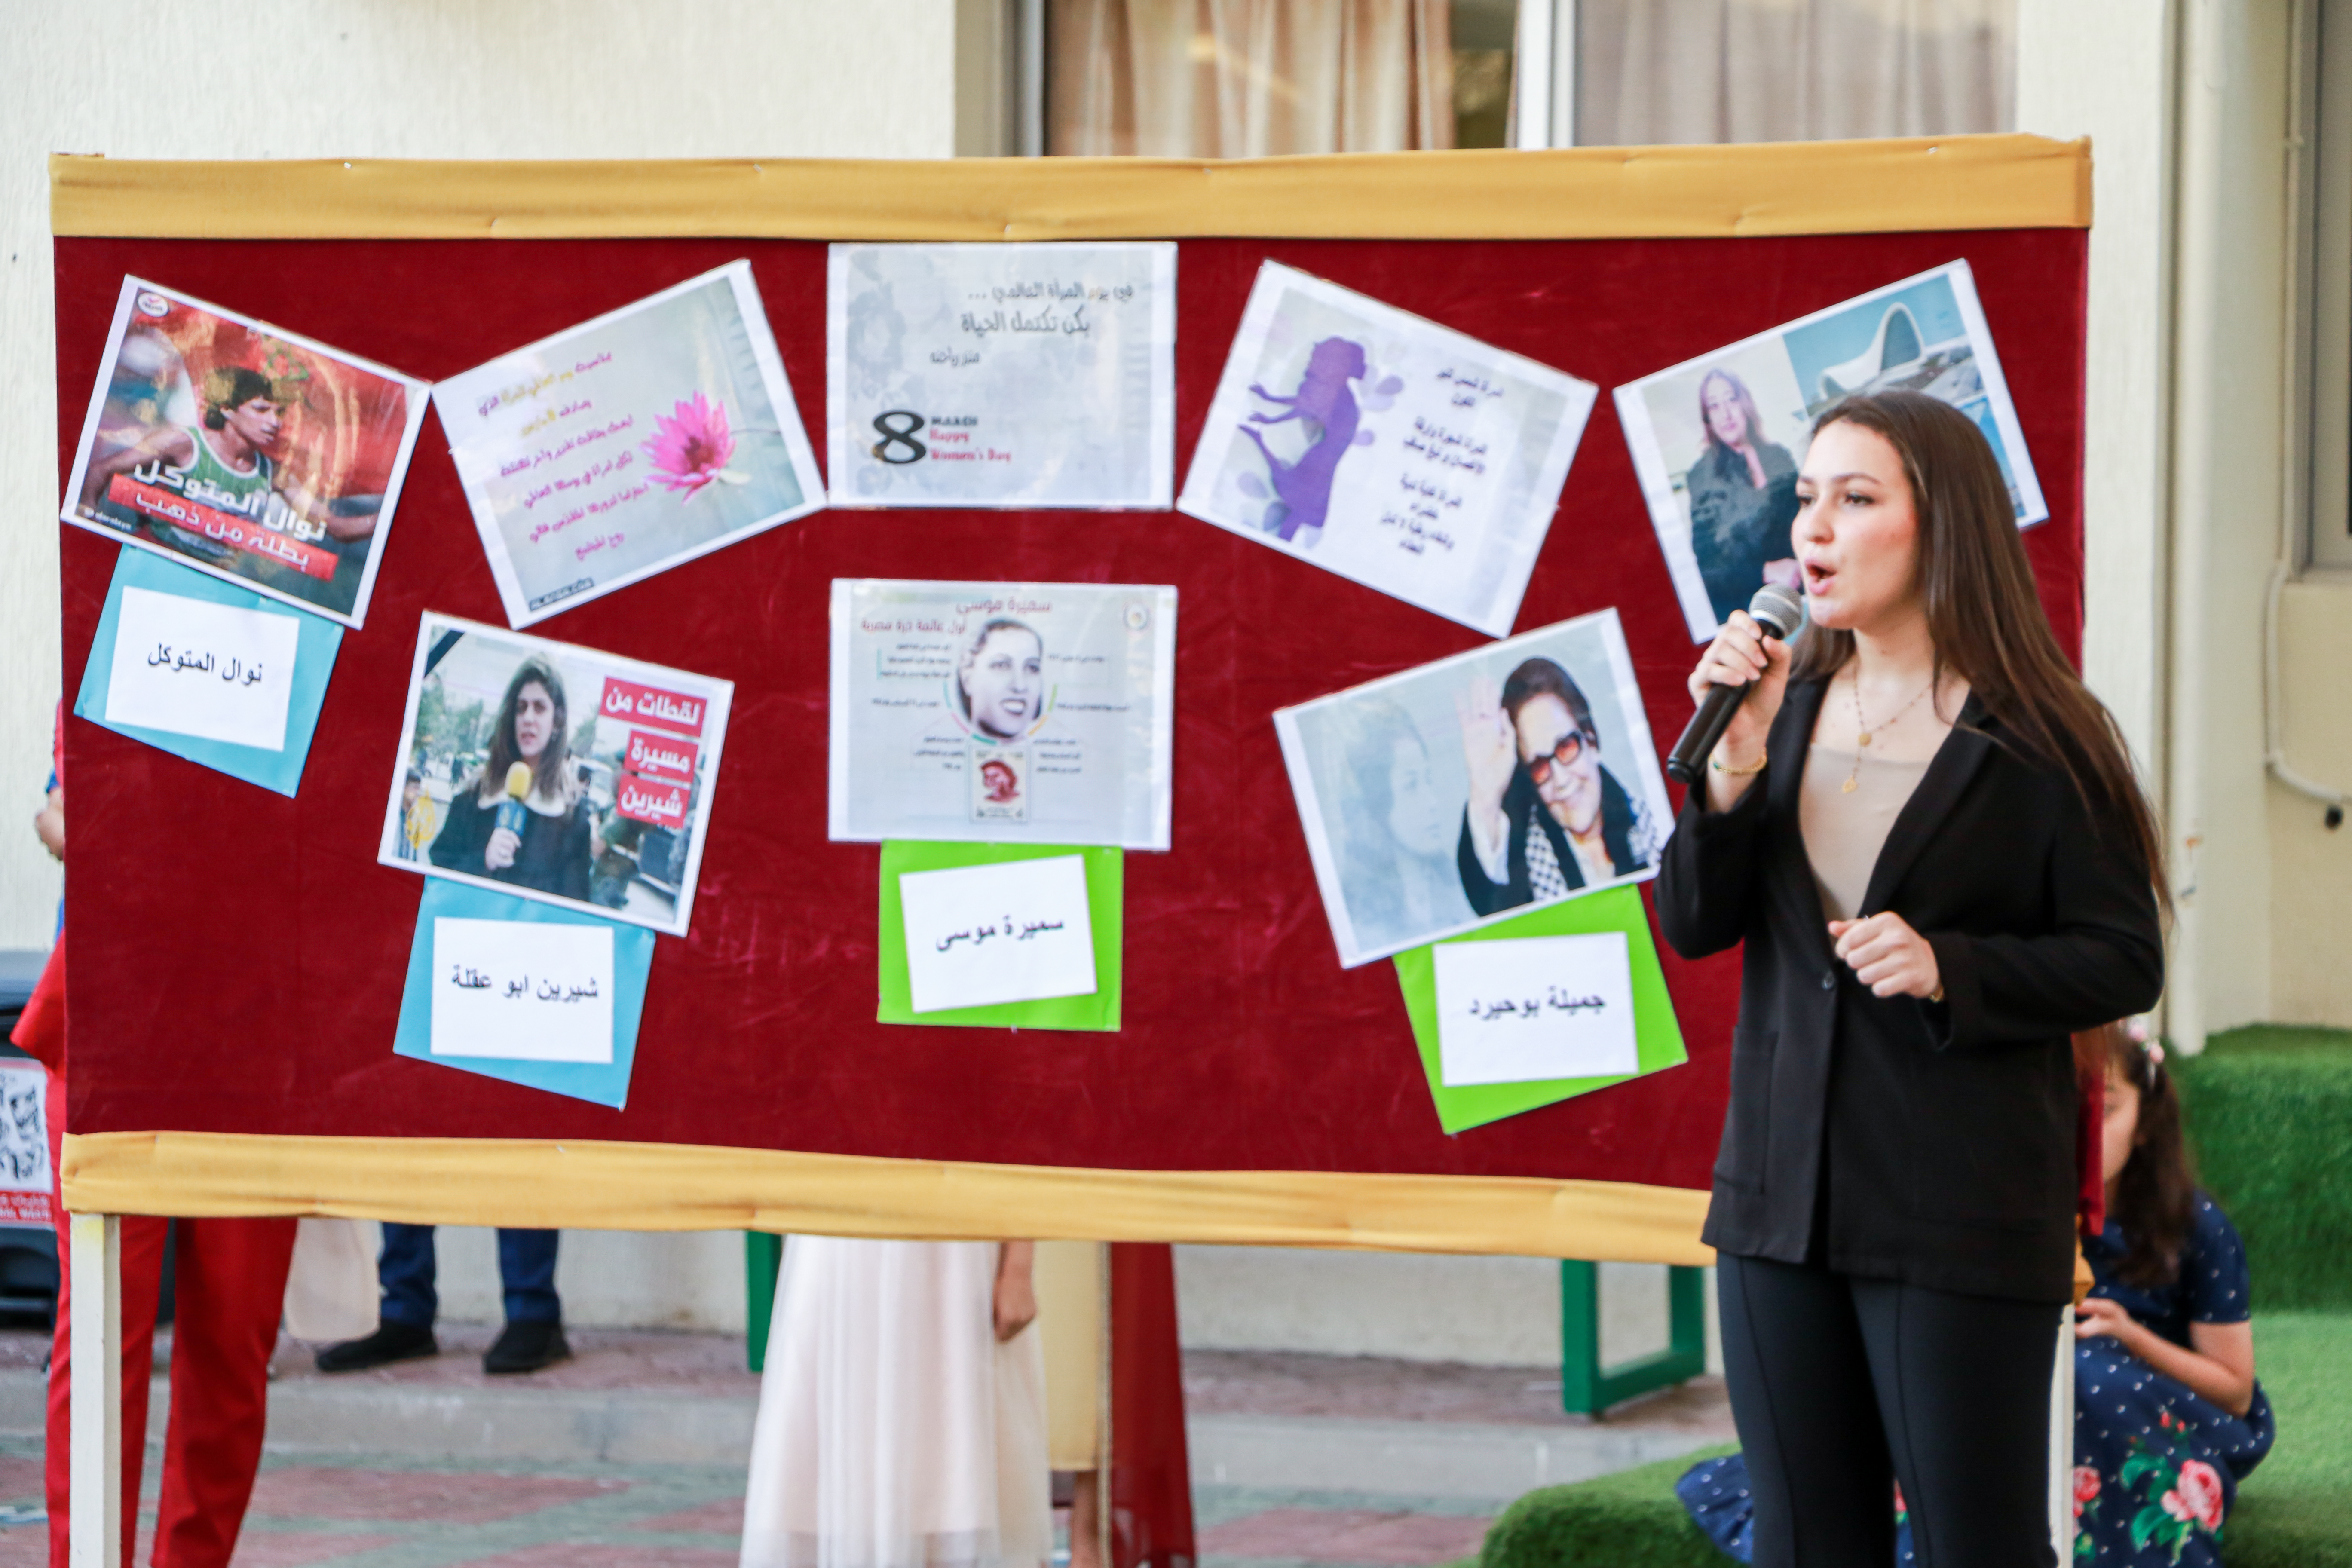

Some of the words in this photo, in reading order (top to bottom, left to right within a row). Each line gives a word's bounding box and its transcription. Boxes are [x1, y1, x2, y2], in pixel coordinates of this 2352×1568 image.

[961, 310, 1006, 338] الحياة
[872, 410, 926, 464] 8
[134, 459, 258, 516] المتوكل
[136, 493, 200, 526] ذهب
[263, 506, 327, 542] نوال
[205, 515, 243, 543] من
[248, 530, 309, 573] بطلة
[1008, 596, 1050, 615] سميرة
[148, 642, 214, 672] المتوكل
[222, 657, 263, 686] نوال
[606, 686, 633, 713] من
[637, 692, 700, 726] لقطات
[631, 737, 690, 773] مسيرة
[621, 785, 683, 820] شيرين
[936, 925, 996, 952] موسى
[1003, 914, 1064, 940] سميرة
[452, 964, 492, 988] عقلة
[502, 974, 529, 999] ابو
[537, 977, 598, 1003] شيرين
[1469, 999, 1540, 1021] بوحيرد
[1548, 985, 1606, 1015] جميلة
